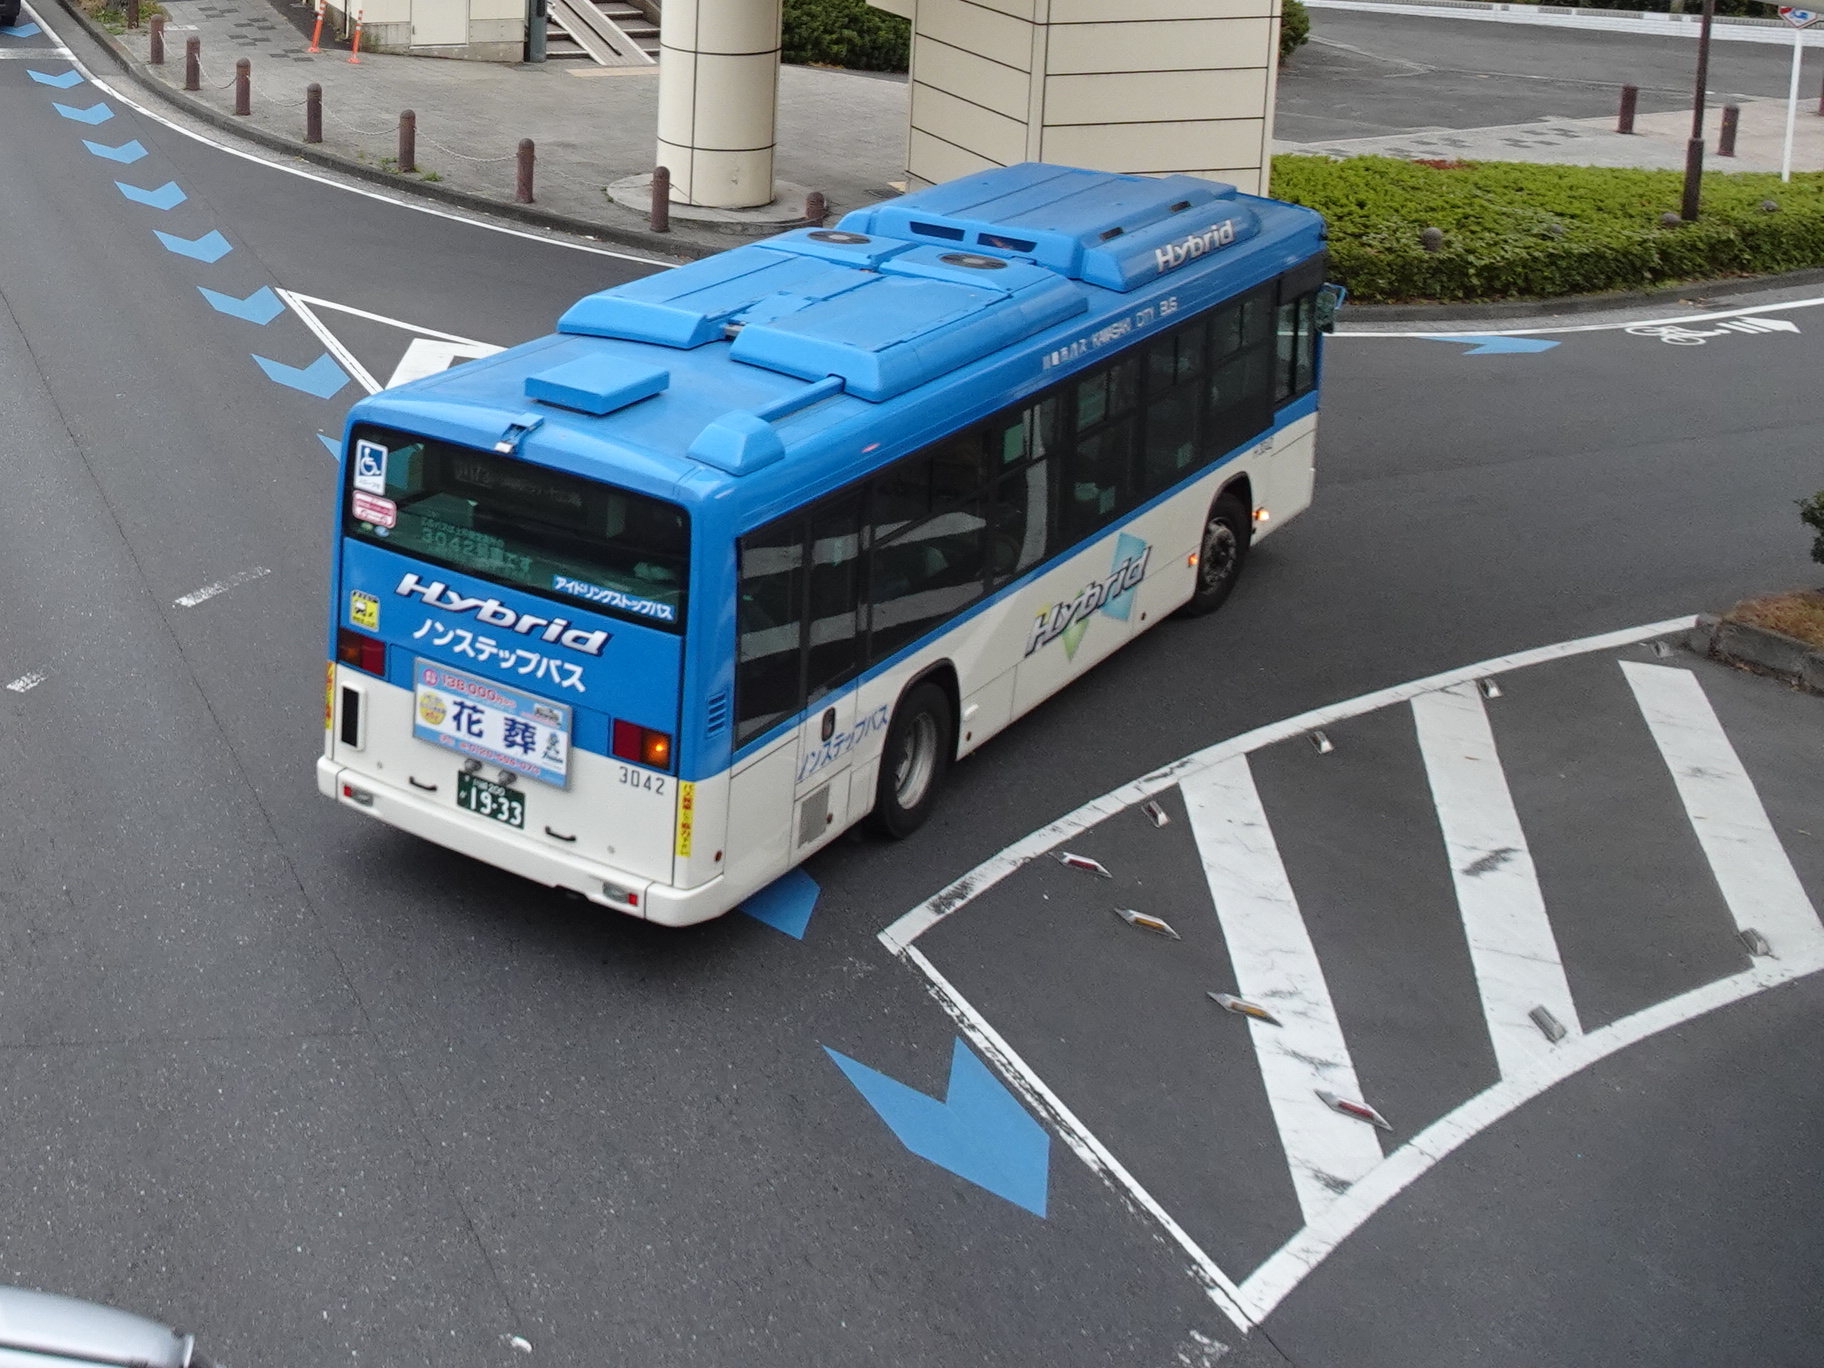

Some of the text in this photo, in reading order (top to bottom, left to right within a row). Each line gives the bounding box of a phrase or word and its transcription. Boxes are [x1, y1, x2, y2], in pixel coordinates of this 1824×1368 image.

[1155, 218, 1234, 272] Hybrid
[395, 572, 612, 656] Hybrid
[554, 575, 675, 621] アイドリングストップバス
[1024, 545, 1152, 658] Hybrid
[413, 618, 587, 693] ノンステップバス
[797, 704, 888, 781] ノンステップバス
[470, 786, 523, 826] 19-33
[618, 765, 665, 796] 3042
